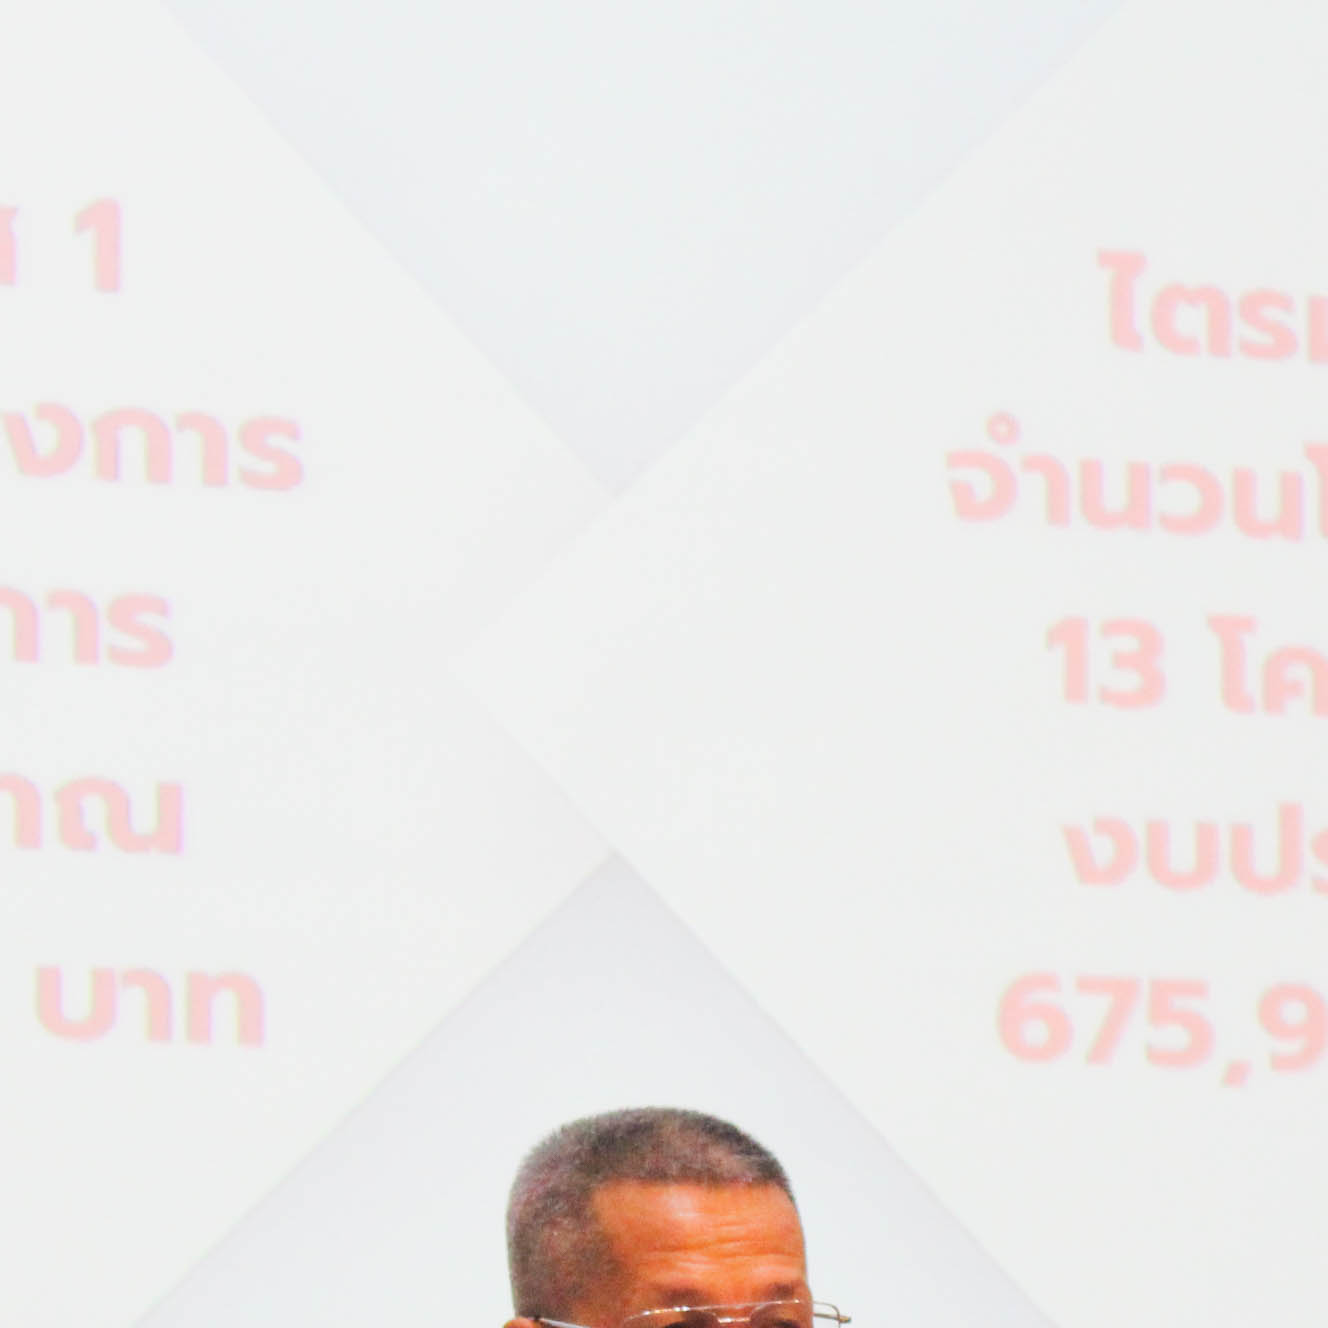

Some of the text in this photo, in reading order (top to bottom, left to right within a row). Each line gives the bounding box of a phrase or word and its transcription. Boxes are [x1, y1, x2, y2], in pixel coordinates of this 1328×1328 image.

[74, 197, 124, 293] 1
[1046, 615, 1169, 711] 13
[36, 965, 267, 1050] บาท
